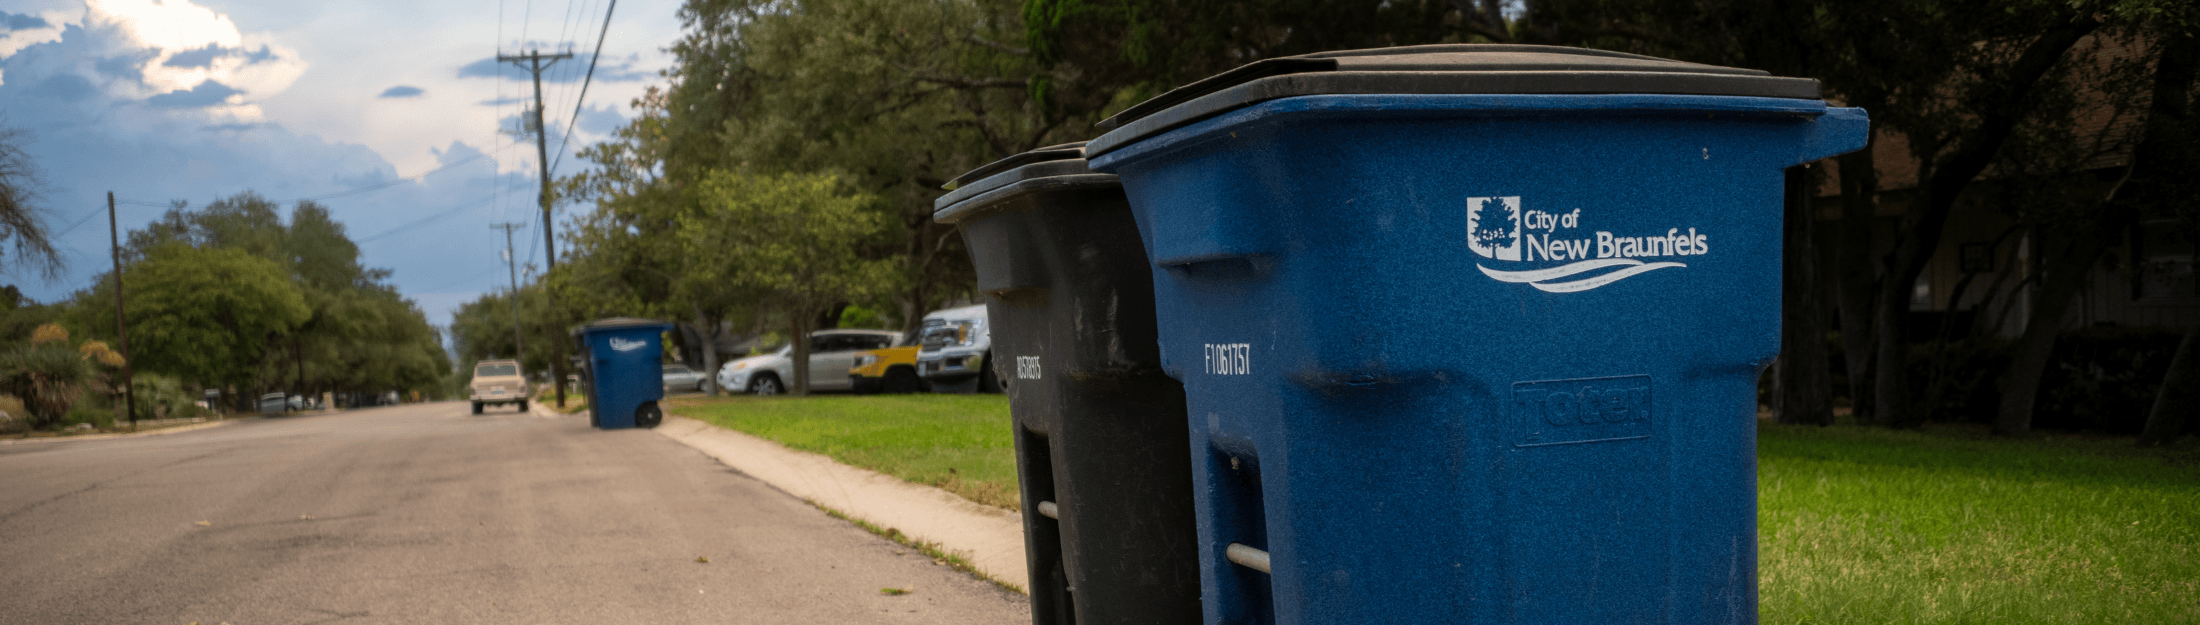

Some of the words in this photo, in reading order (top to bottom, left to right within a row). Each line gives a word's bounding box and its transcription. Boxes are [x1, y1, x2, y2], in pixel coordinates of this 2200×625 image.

[1524, 210, 1558, 232] City
[1561, 208, 1581, 228] of
[1526, 233, 1591, 261] New
[1596, 227, 1708, 259] Braunfels
[1204, 343, 1250, 376] F1061757
